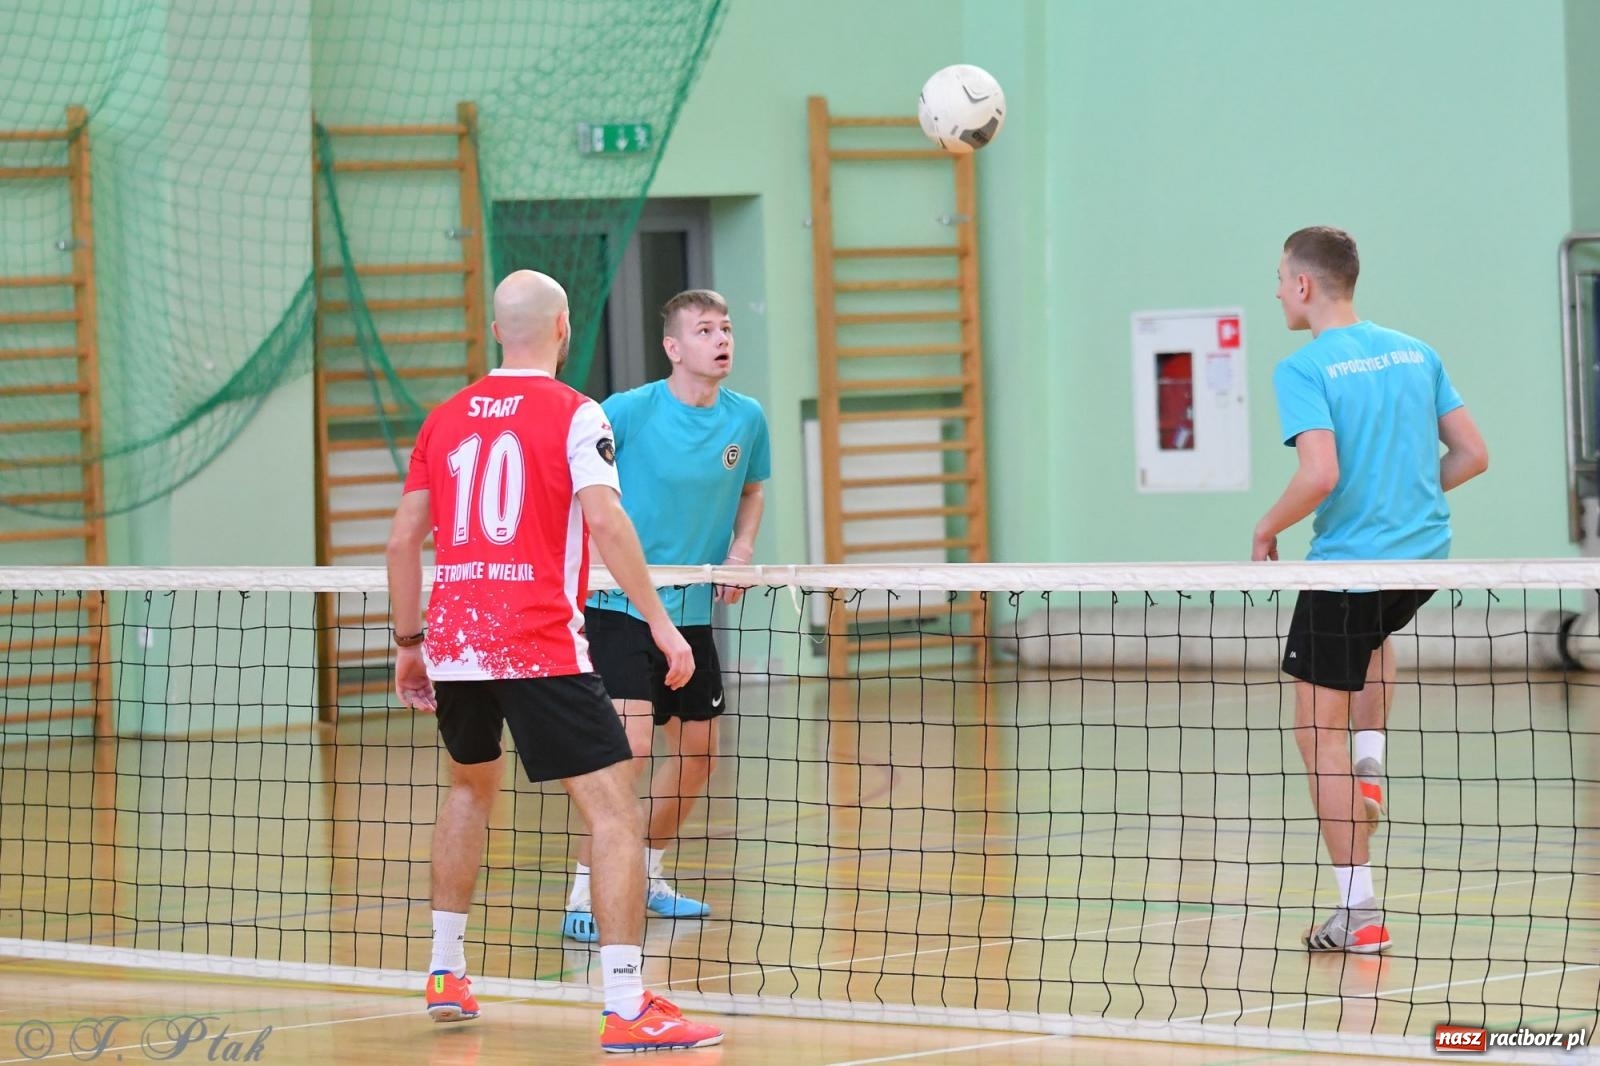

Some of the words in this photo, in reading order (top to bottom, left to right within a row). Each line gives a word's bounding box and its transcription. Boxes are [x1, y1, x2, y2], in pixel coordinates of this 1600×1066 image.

[467, 394, 525, 419] START
[447, 429, 526, 546] 10
[488, 562, 535, 581] WIELKIE
